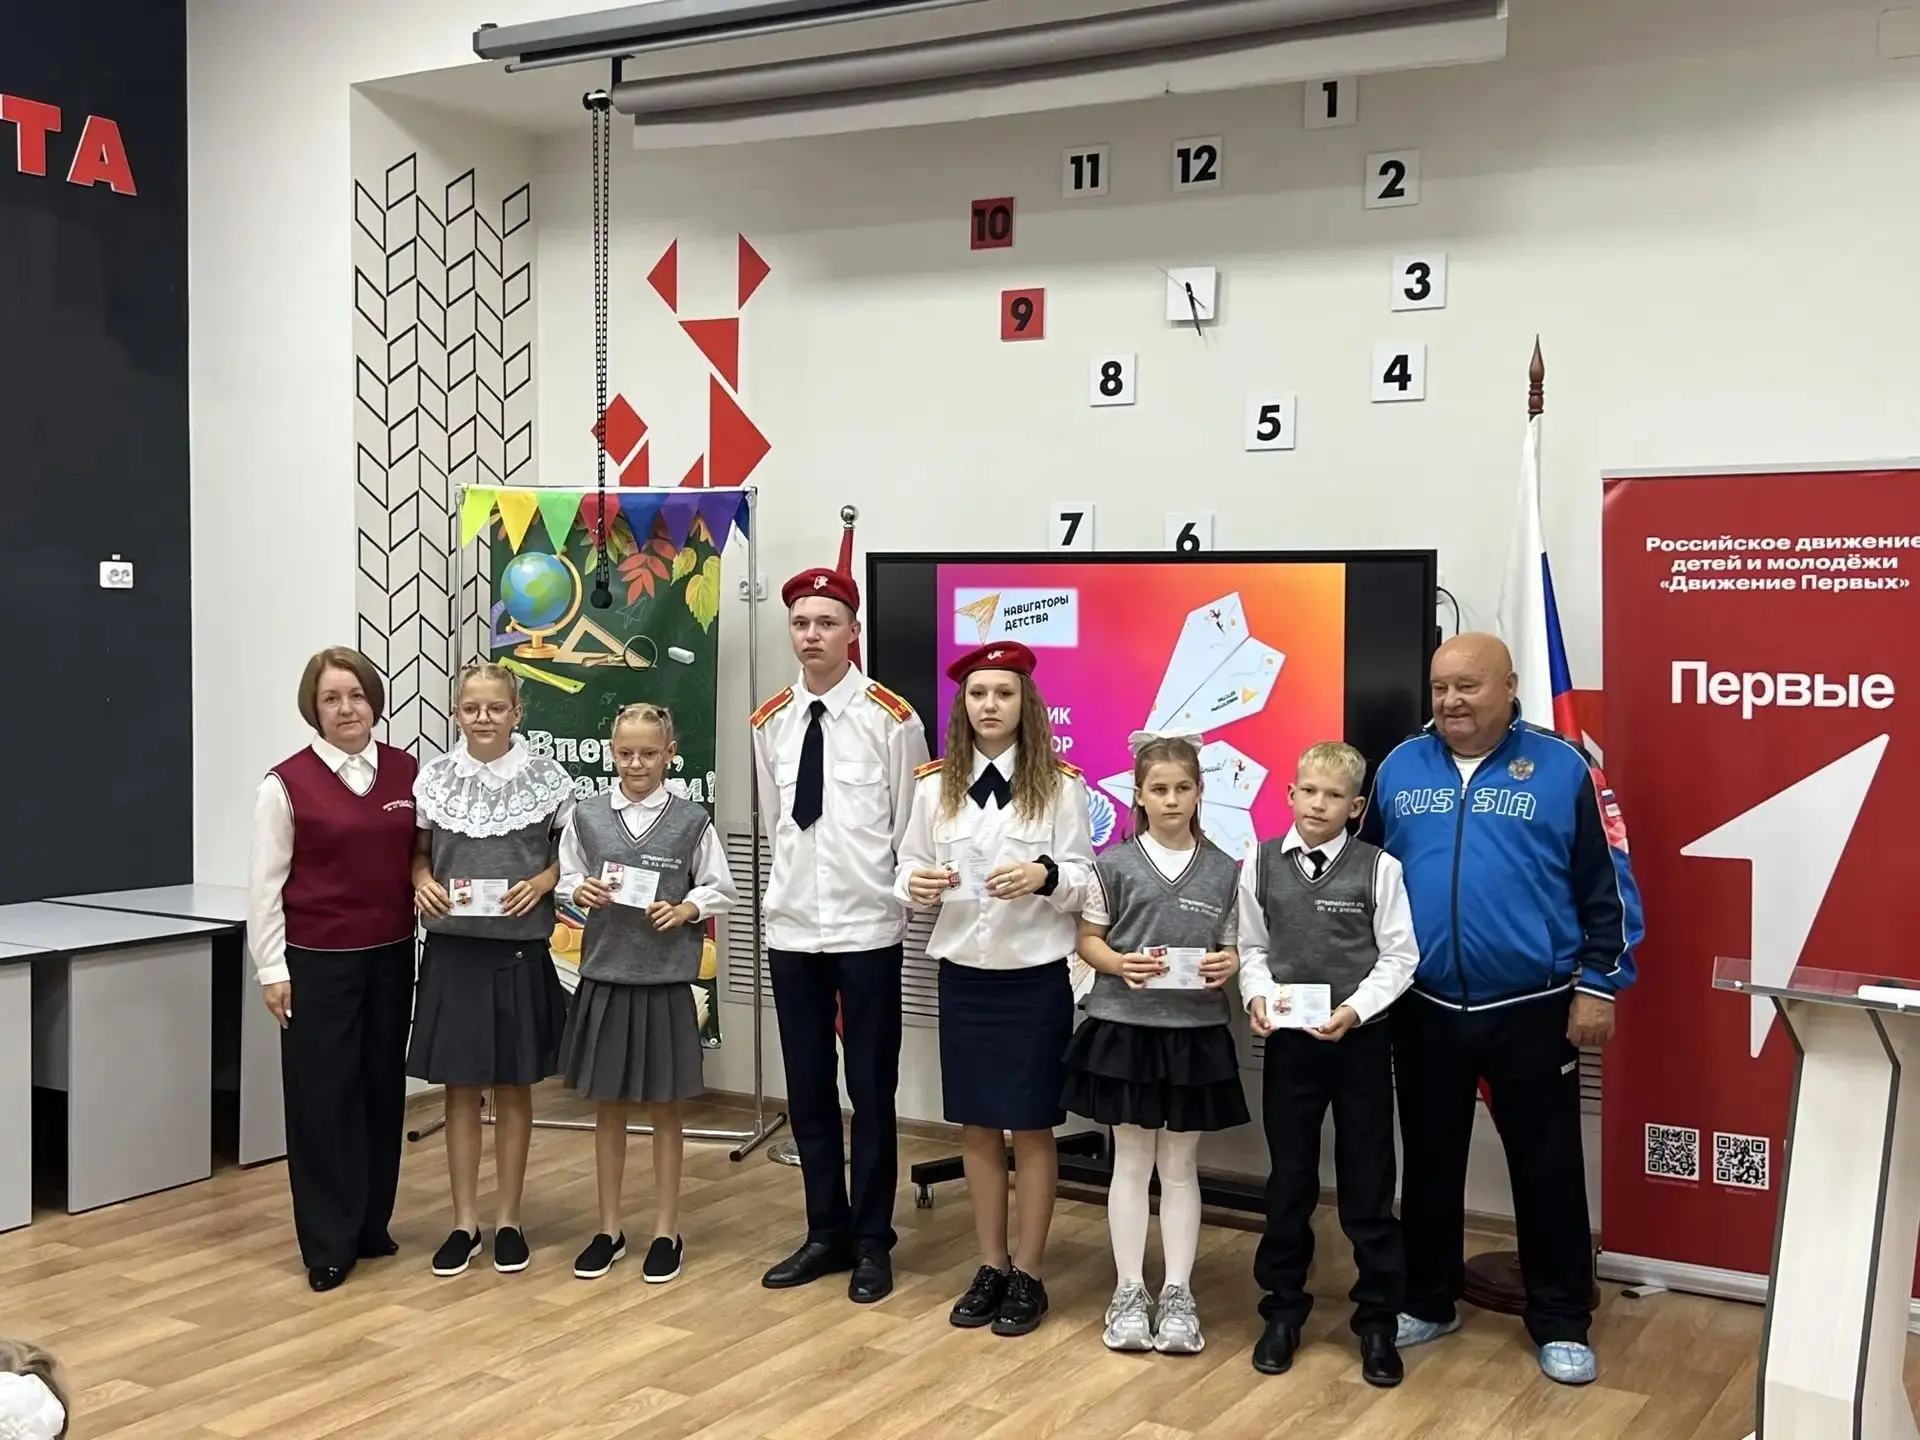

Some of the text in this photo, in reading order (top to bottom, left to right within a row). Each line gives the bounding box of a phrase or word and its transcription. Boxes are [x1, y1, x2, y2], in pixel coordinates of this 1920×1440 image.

[1323, 81, 1338, 118] 1
[1070, 153, 1100, 190] 11
[1177, 144, 1217, 184] 12
[1378, 160, 1406, 199] 2
[974, 205, 1011, 241] 10
[1404, 262, 1431, 300] 3
[1011, 297, 1033, 331] 9
[1100, 361, 1123, 397] 8
[1383, 355, 1411, 390] 4
[1257, 405, 1281, 440] 5
[1060, 512, 1084, 546] 7
[1176, 522, 1200, 551] 6
[1646, 536, 1920, 552] Российское движение
[1671, 554, 1898, 573] детей и молодёжи
[1660, 575, 1910, 593] «Движение Первых»
[1003, 595, 1069, 617] НАВИГАТОРЫ
[1004, 612, 1049, 632] ДЕТСТВА
[1671, 660, 1895, 720] Первые
